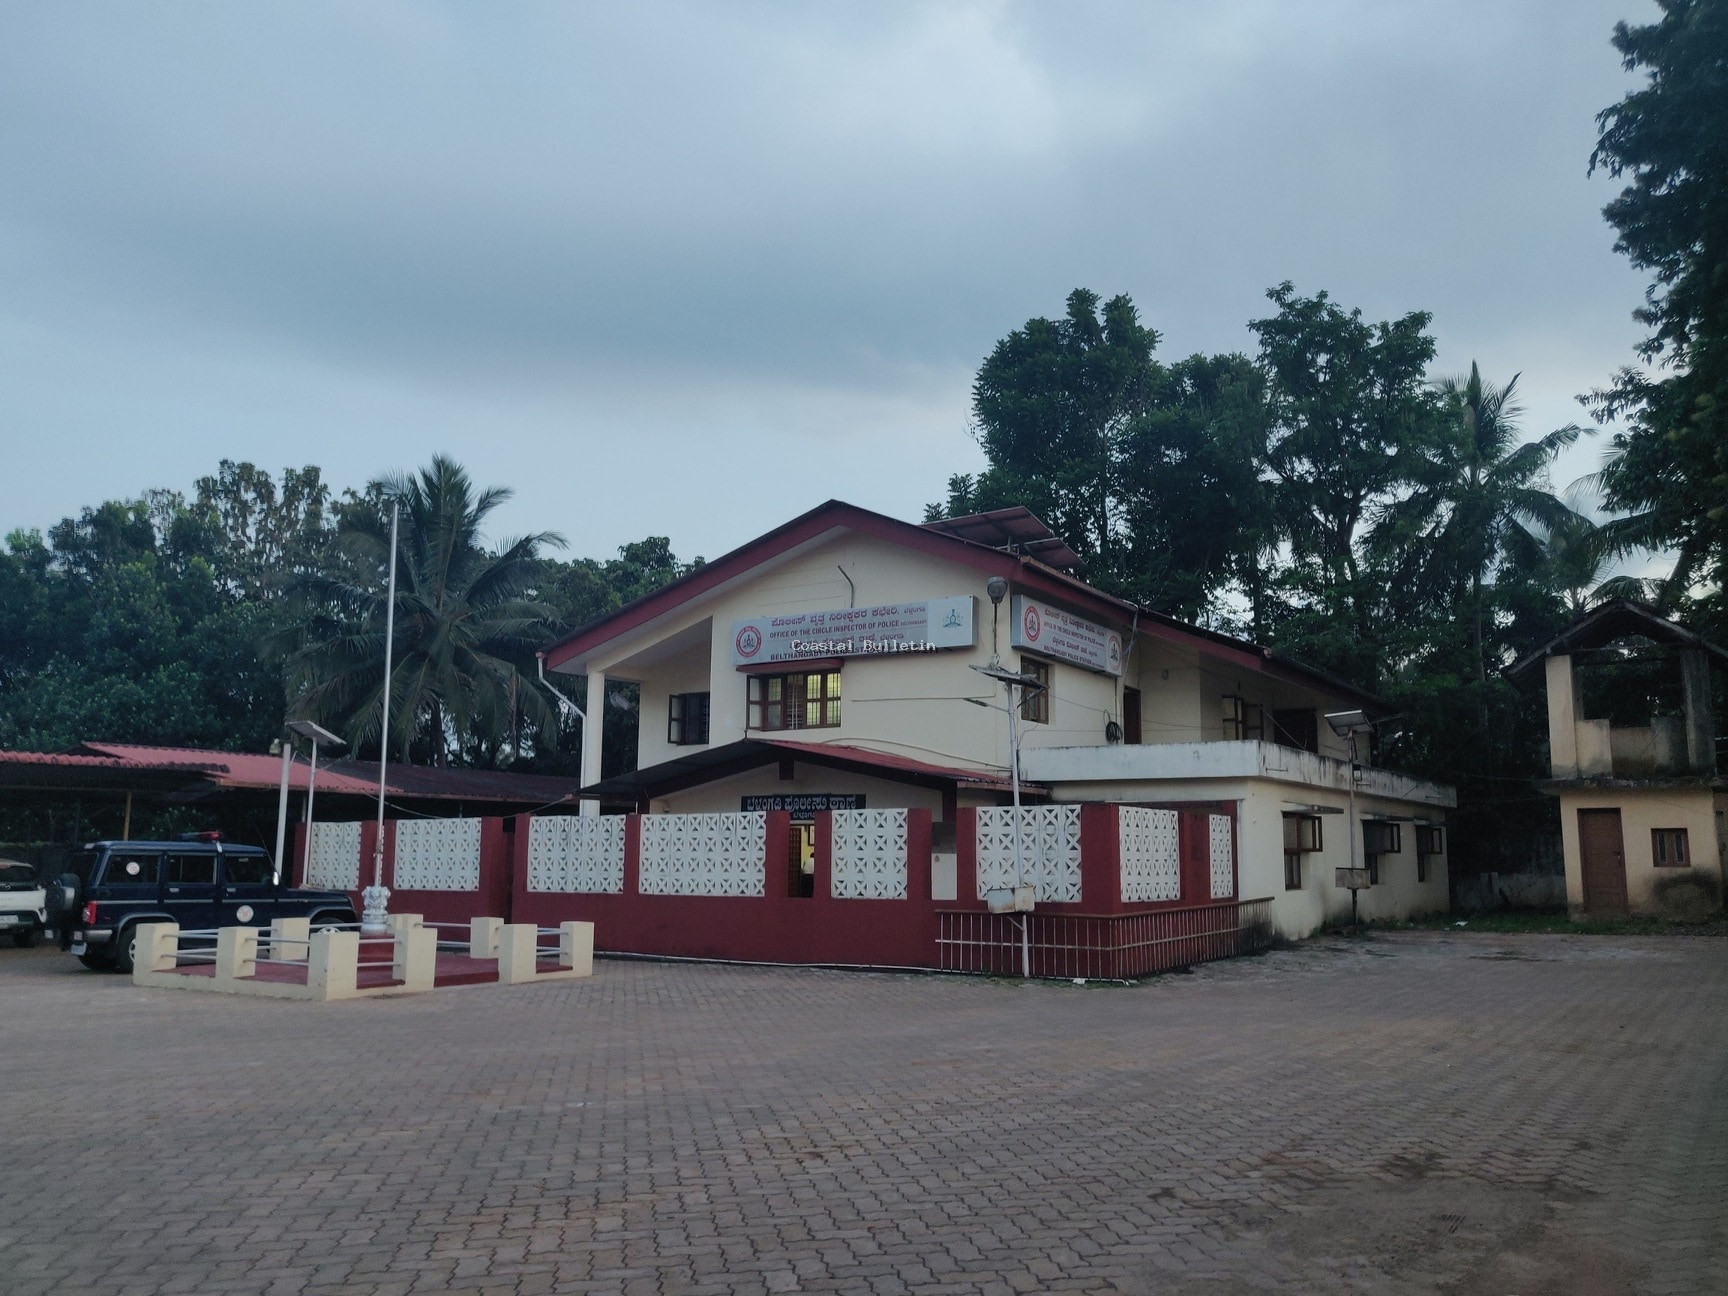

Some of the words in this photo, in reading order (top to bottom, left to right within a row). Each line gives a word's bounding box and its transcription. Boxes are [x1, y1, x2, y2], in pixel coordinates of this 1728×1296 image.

[769, 630, 789, 639] OFFICE
[790, 629, 798, 638] OF
[800, 627, 811, 636] THE
[812, 625, 832, 635] CIRCLE
[833, 622, 867, 633] INSPECTOR
[868, 621, 876, 630] OF
[877, 620, 899, 629] POLICE
